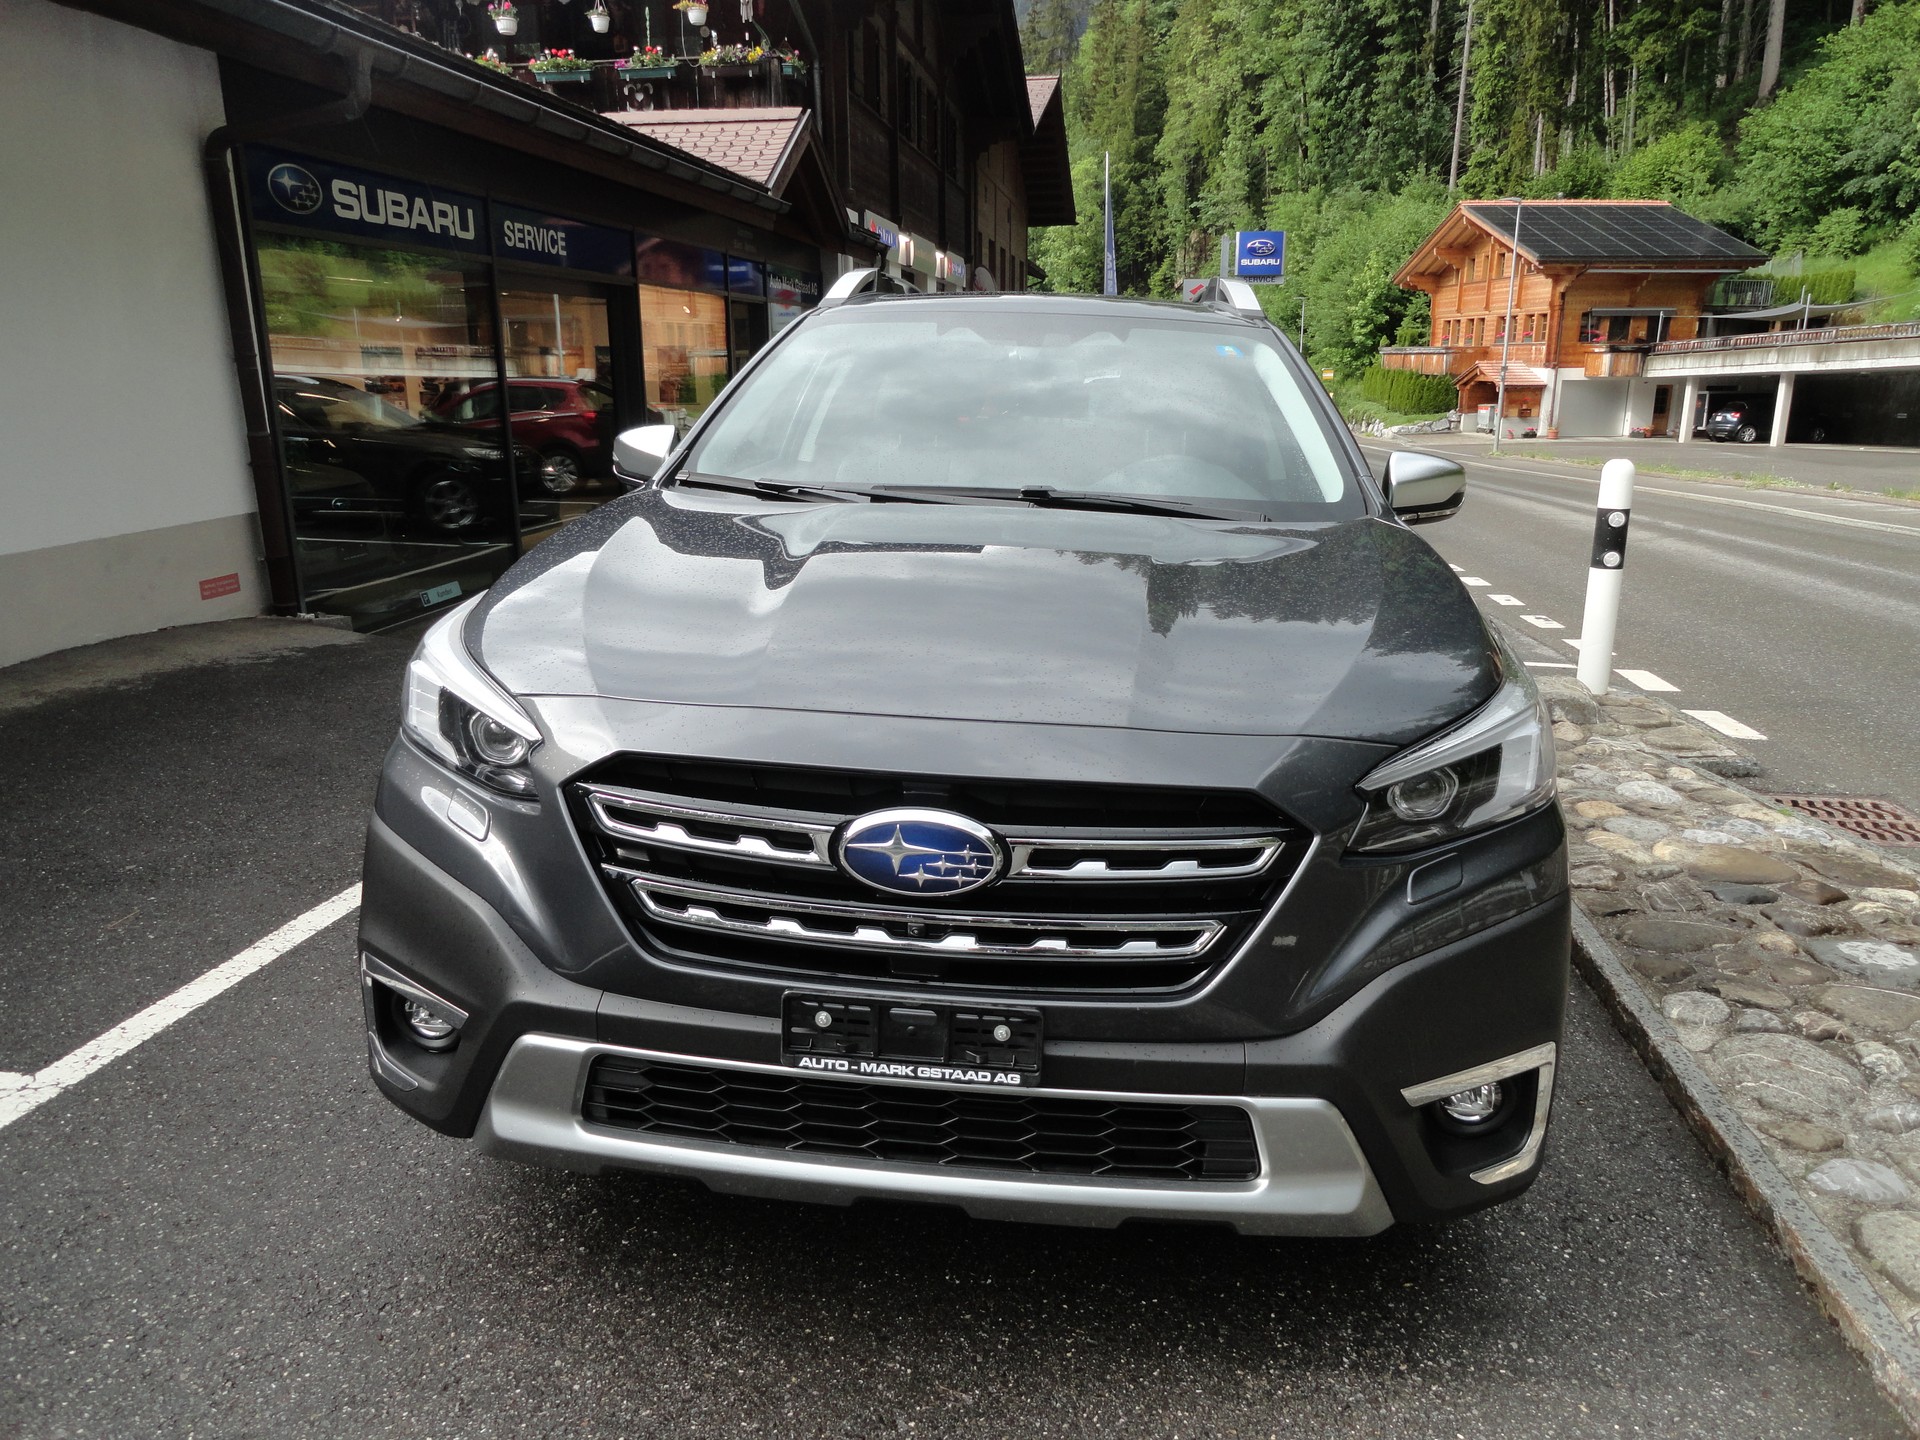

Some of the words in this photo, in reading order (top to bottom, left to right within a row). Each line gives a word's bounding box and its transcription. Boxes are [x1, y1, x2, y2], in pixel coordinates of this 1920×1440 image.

[331, 179, 475, 240] SUBARU
[504, 220, 567, 256] SERVICE
[1240, 258, 1280, 266] SUBARU
[1243, 275, 1276, 283] SERVICE
[799, 1056, 848, 1071] AUTO
[860, 1062, 915, 1077] MARK
[917, 1066, 991, 1082] GSTAAD
[993, 1073, 1021, 1085] AG
